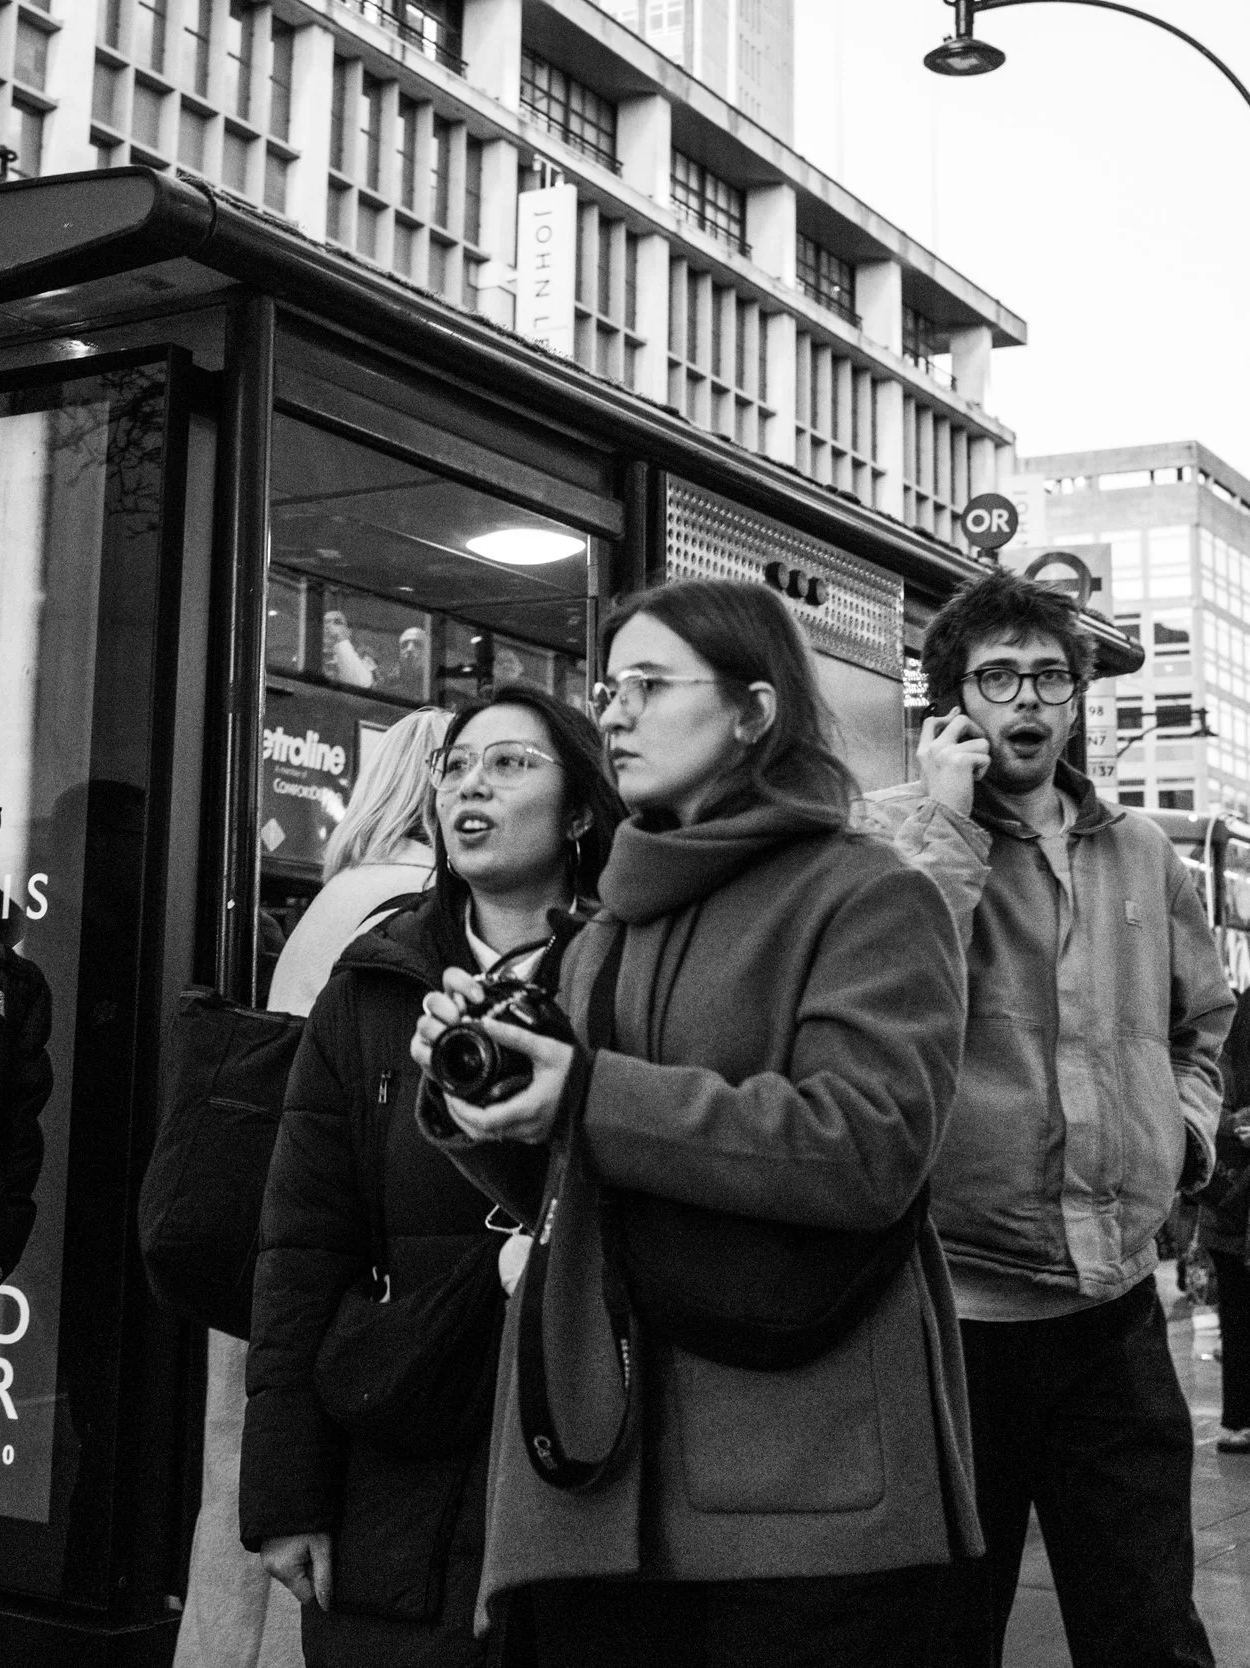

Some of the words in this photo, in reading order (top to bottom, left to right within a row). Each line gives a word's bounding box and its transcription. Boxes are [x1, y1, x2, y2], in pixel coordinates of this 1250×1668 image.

[534, 210, 552, 297] JOHN
[966, 508, 1011, 533] OR
[1088, 705, 1104, 717] 98
